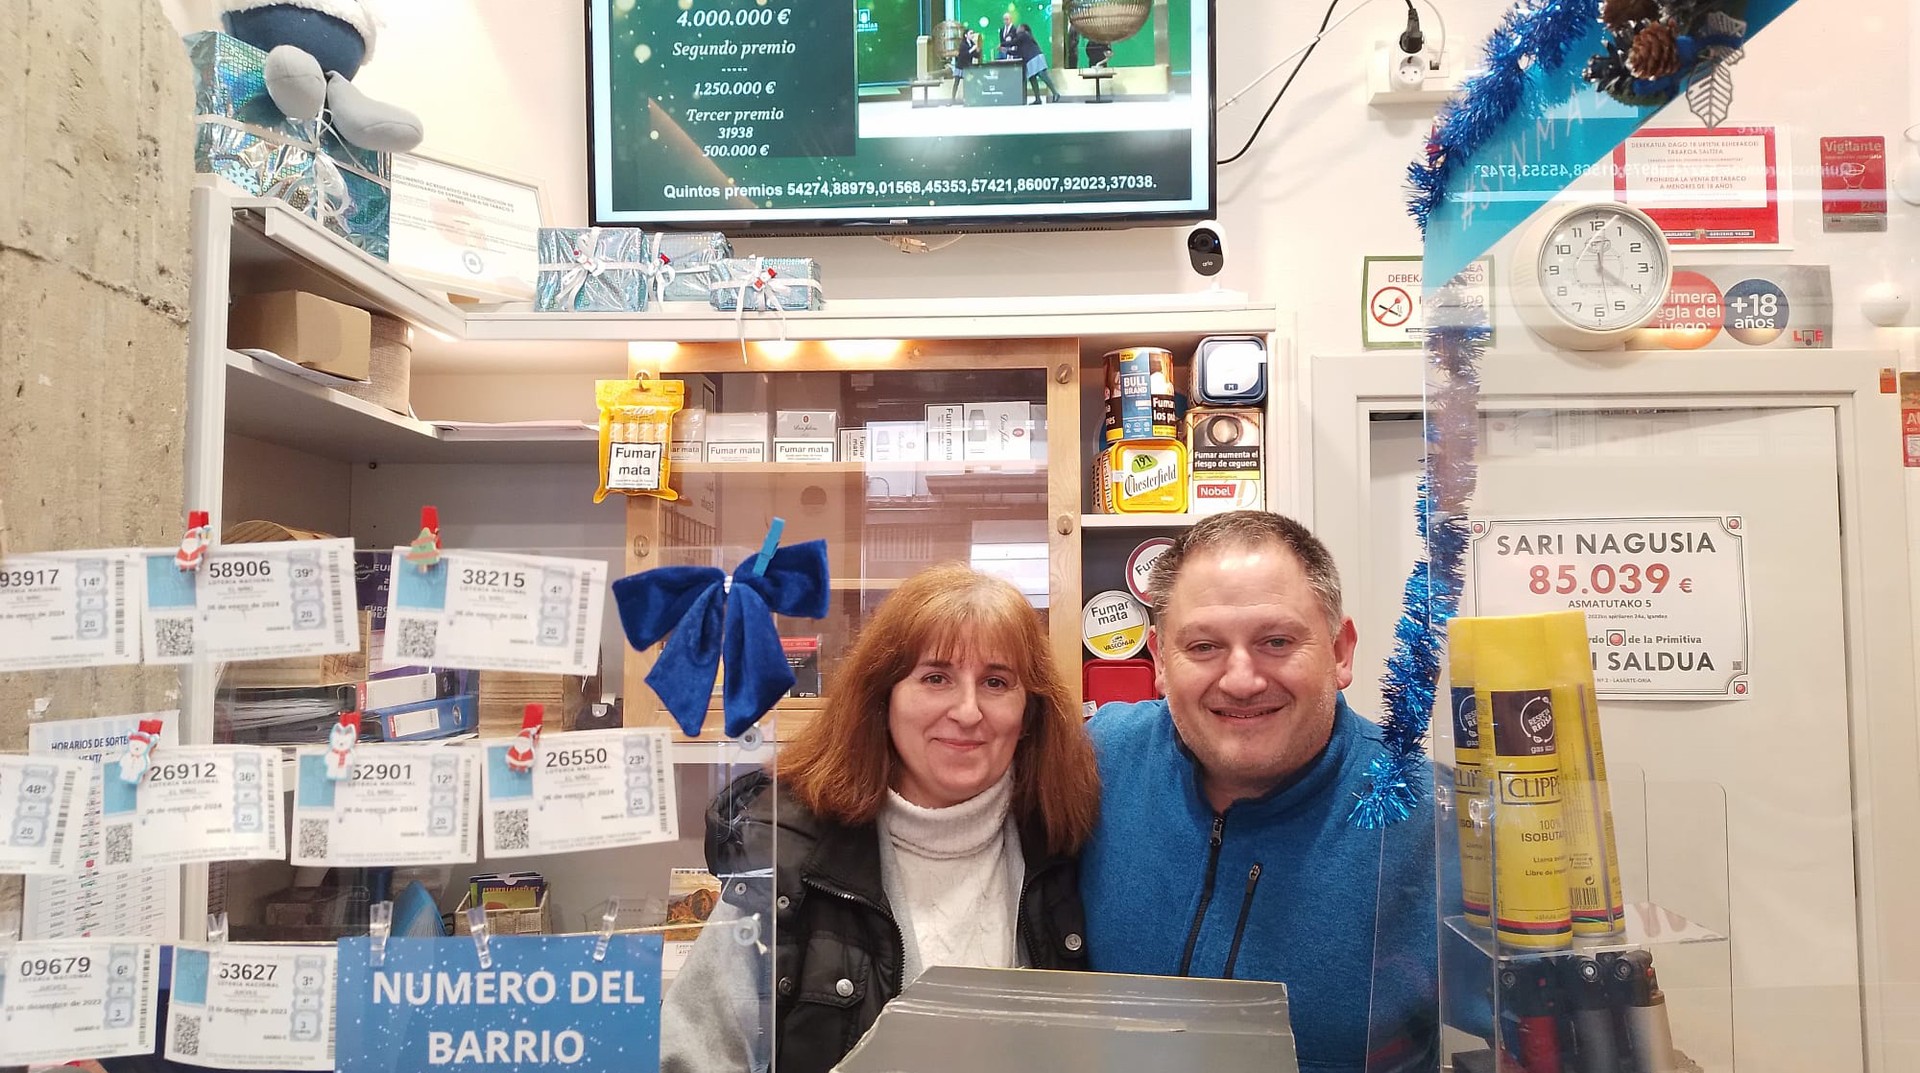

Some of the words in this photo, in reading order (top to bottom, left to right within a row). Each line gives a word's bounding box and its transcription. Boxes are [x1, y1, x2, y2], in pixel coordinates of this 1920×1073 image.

[677, 9, 772, 27] 4.000.000
[777, 8, 791, 25] €
[672, 39, 737, 60] Segundo
[740, 40, 796, 60] premio
[694, 82, 761, 95] 1.250.000
[765, 81, 776, 94] €
[686, 108, 732, 121] Tercer
[734, 107, 784, 125] premio
[718, 127, 753, 139] 31938
[702, 145, 757, 157] 500.000
[759, 144, 769, 156] €
[1825, 141, 1882, 154] Vigilante
[664, 184, 720, 199] Quintos
[725, 183, 783, 200] premios
[787, 175, 1157, 198] 54274,88979,01568,45353,57421,86007,92023,37038.
[1572, 228, 1582, 238] 11
[1617, 226, 1622, 237] 1
[1556, 245, 1571, 255] 10
[1630, 243, 1641, 253] 2
[1549, 265, 1560, 275] 9
[1638, 263, 1649, 273] 3
[1557, 286, 1568, 296] 8
[1572, 302, 1582, 312] 7
[1615, 301, 1626, 311] 5
[1695, 304, 1721, 318] del
[1731, 294, 1778, 317] +18
[1594, 307, 1605, 317] 6
[1734, 315, 1775, 329] años
[1123, 376, 1148, 387] BULL
[1124, 386, 1148, 395] BRAND
[1153, 397, 1175, 408] Fuma
[1154, 410, 1166, 421] los
[615, 447, 657, 459] Fumar
[710, 446, 738, 455] Fumar
[739, 446, 761, 454] mata
[779, 445, 807, 453] Fumar
[807, 445, 829, 453] mata
[1194, 451, 1218, 459] Fumar
[1218, 451, 1251, 459] aumenta
[1251, 450, 1259, 459] el
[1194, 460, 1217, 469] riesgo
[1228, 461, 1257, 469] ceguera
[619, 465, 651, 476] mata
[1124, 464, 1177, 497] Chesterfield
[1200, 486, 1232, 497] Nobel
[1497, 535, 1563, 556] SARI
[1576, 532, 1716, 555] NAGUSIA
[209, 560, 271, 579] 58906
[0, 569, 59, 588] 93917
[462, 569, 526, 588] 38215
[1529, 563, 1670, 595] 85.039
[1678, 578, 1693, 594] €
[1091, 600, 1130, 618] Fumar
[1568, 600, 1642, 609] ASMATUTAKO
[1645, 599, 1652, 608] 5
[301, 610, 313, 619] 20
[1097, 611, 1129, 626] mata
[84, 620, 96, 628] 20
[546, 627, 557, 636] 20
[1628, 635, 1641, 644] de
[1643, 635, 1653, 644] la
[1655, 635, 1702, 644] Primitiva
[1607, 652, 1715, 671] SALDUA
[51, 739, 93, 750] HORARIOS
[94, 737, 105, 748] DE
[1530, 746, 1545, 755] gas
[545, 748, 607, 768] 26550
[150, 763, 217, 782] 26912
[633, 797, 643, 806] 20
[241, 814, 252, 822] 20
[435, 816, 446, 825] 20
[20, 826, 33, 835] 20
[21, 957, 91, 977] 09679
[570, 971, 645, 1004] DEL
[428, 1030, 585, 1065] BARRIO
